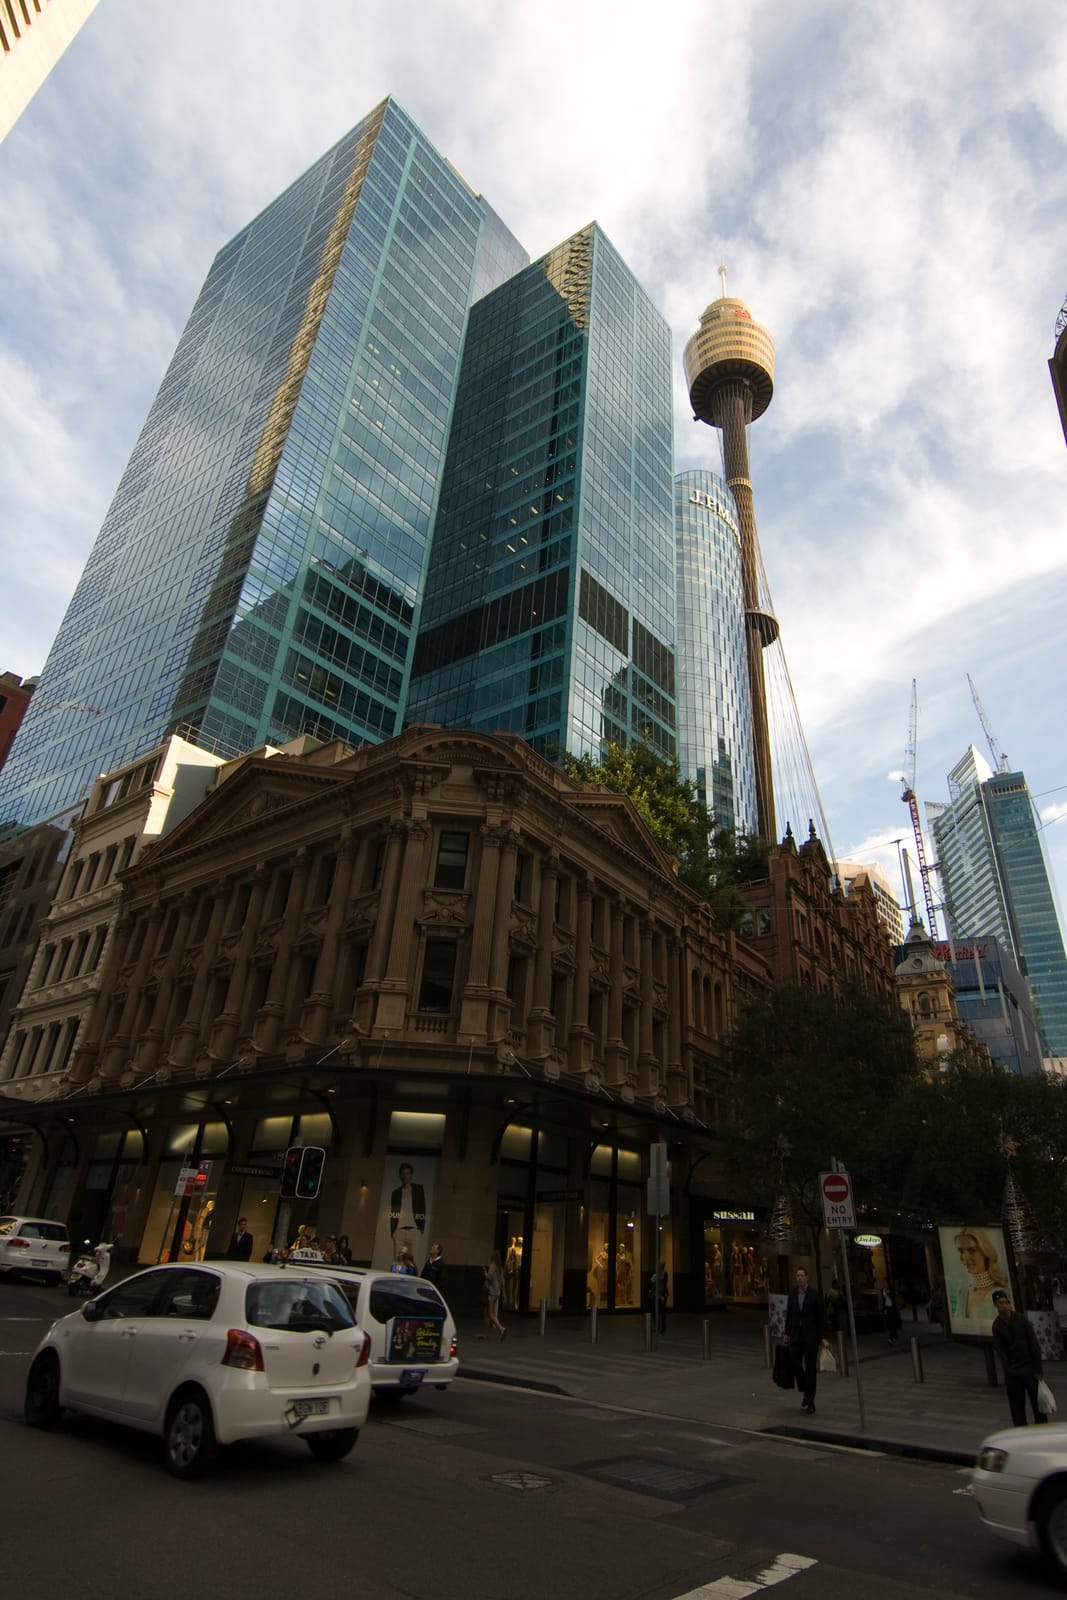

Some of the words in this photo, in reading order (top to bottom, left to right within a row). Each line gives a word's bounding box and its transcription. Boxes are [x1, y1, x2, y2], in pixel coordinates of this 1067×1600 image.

[831, 1205, 847, 1214] NO
[713, 1210, 755, 1220] sussan
[826, 1216, 853, 1225] ENTRY
[300, 1251, 318, 1259] TAXI
